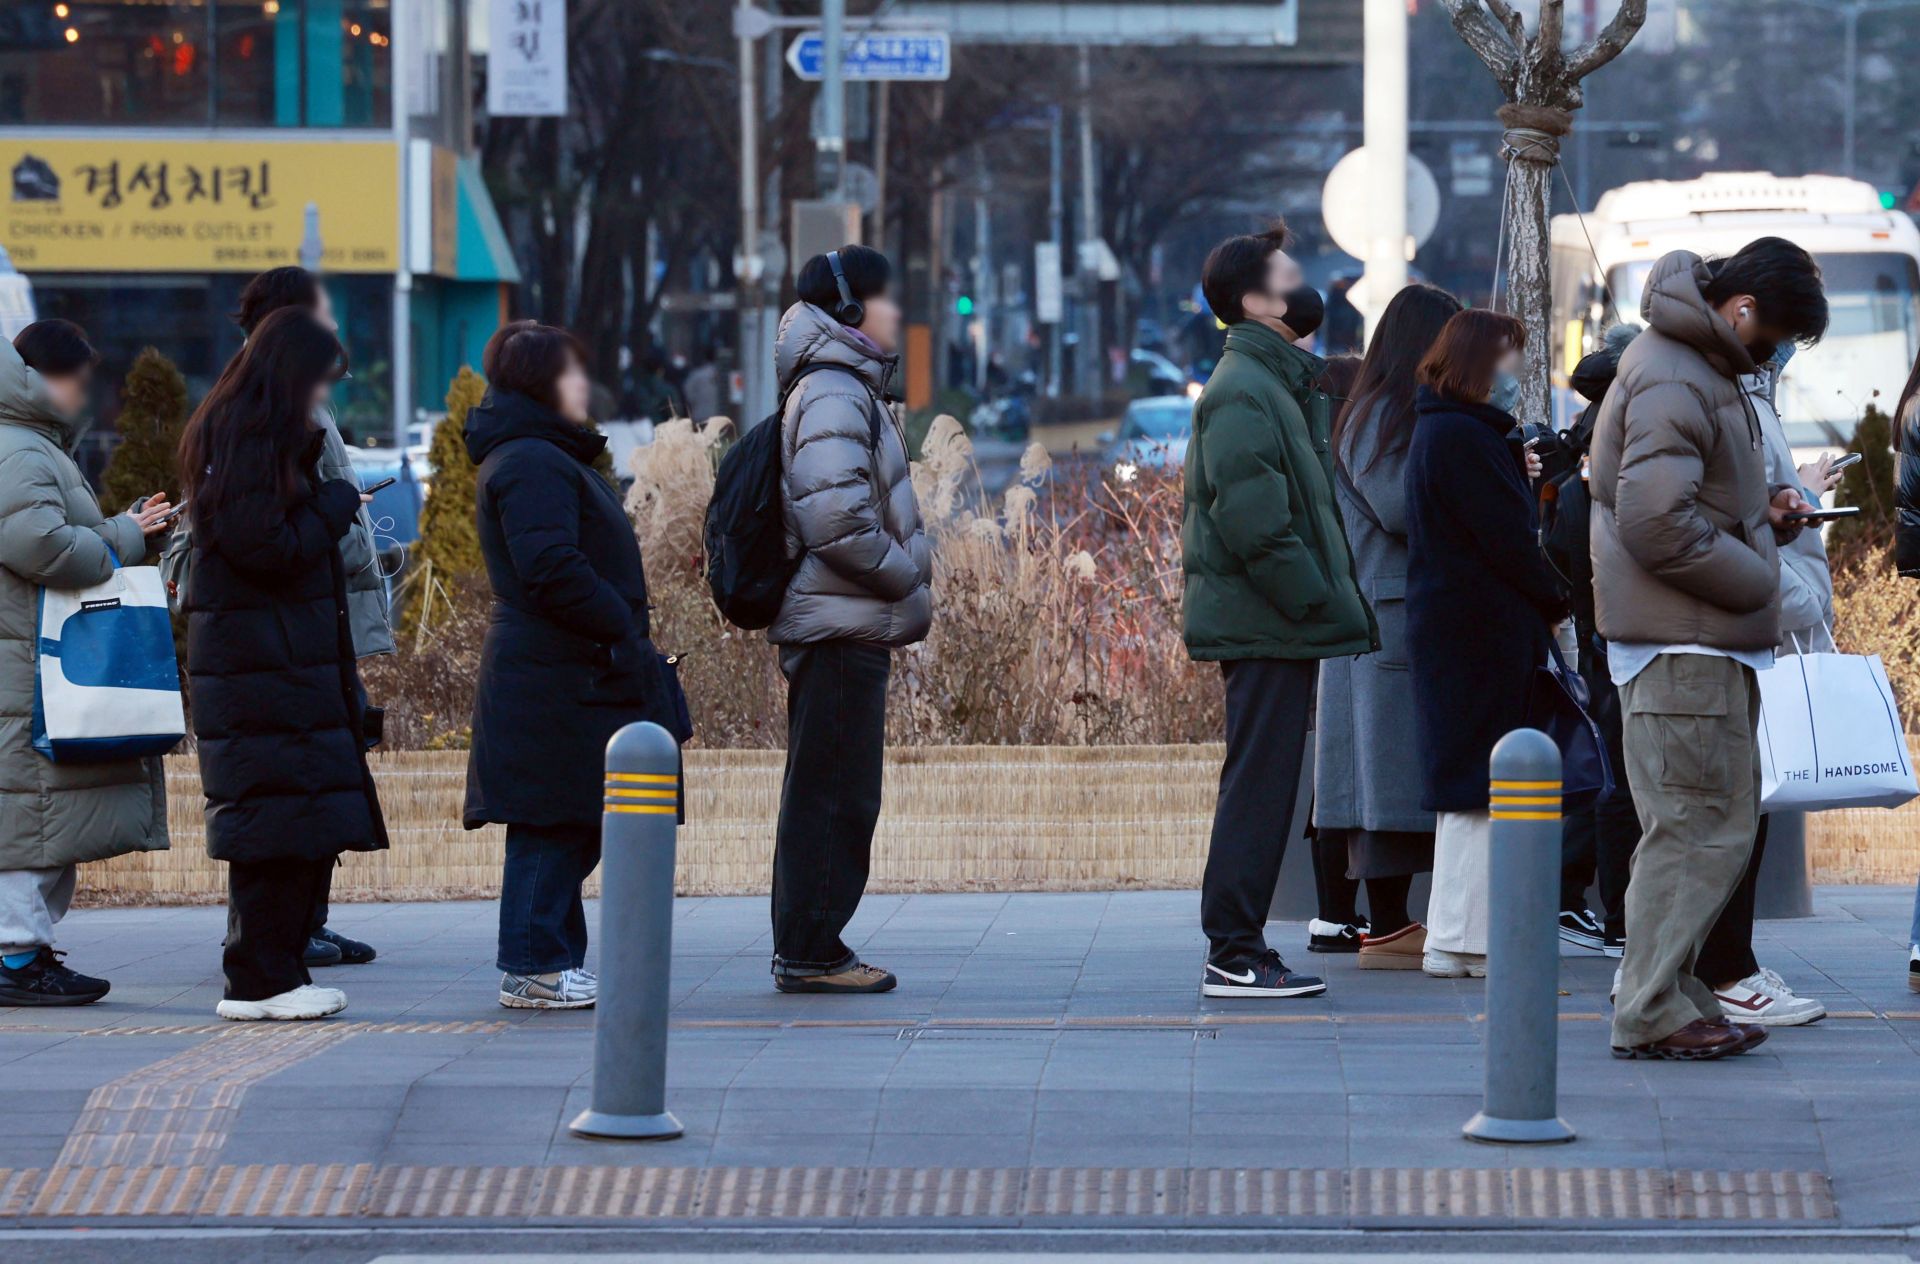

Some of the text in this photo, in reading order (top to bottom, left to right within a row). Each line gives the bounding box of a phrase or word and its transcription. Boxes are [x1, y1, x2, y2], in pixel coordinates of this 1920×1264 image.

[74, 159, 277, 210] 경성치킨
[9, 220, 103, 239] CHICKEN
[131, 221, 186, 239] PORK
[197, 221, 274, 239] CUTLET
[1784, 762, 1899, 781] THE HANDSOME
